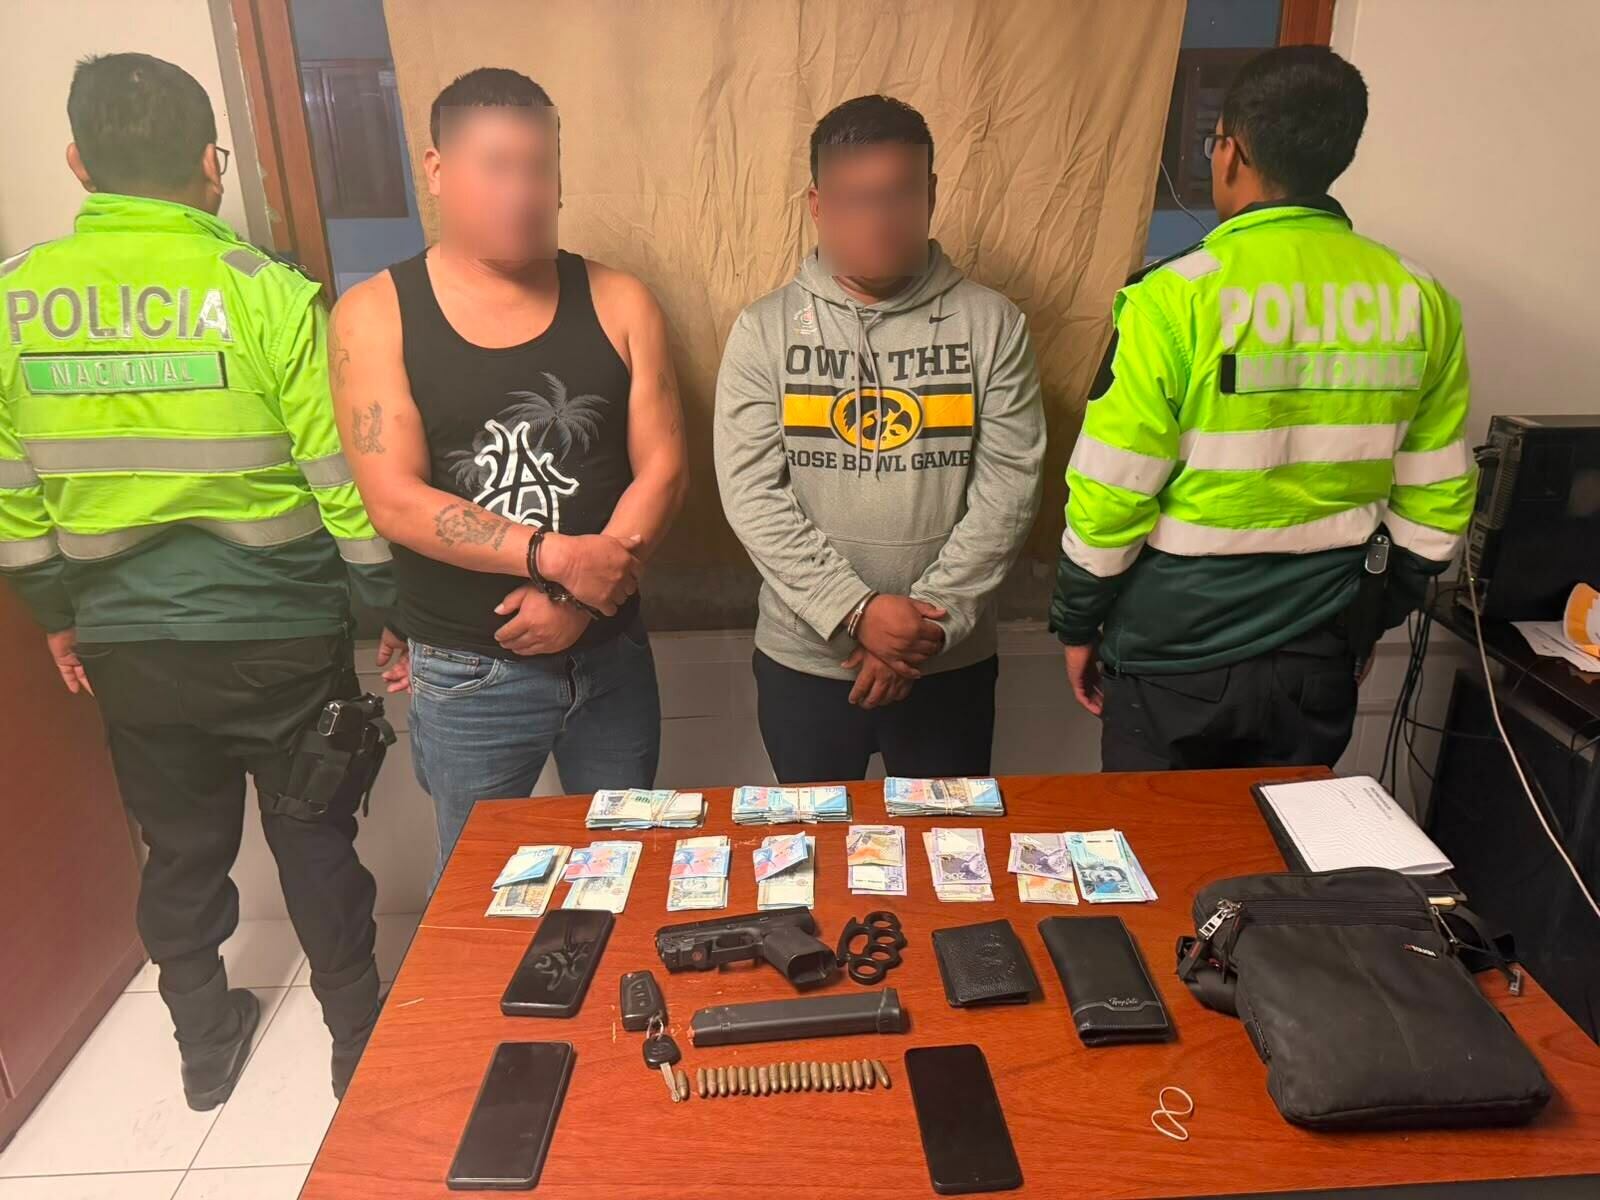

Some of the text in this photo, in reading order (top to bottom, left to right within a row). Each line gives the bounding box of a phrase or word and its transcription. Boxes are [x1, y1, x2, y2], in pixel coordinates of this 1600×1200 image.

[7, 285, 234, 345] POLICIA
[1220, 283, 1421, 347] POLICIA
[49, 357, 194, 386] NACIONAL
[785, 342, 971, 384] OWN THE
[787, 450, 838, 469] ROSE
[911, 450, 971, 471] GAME
